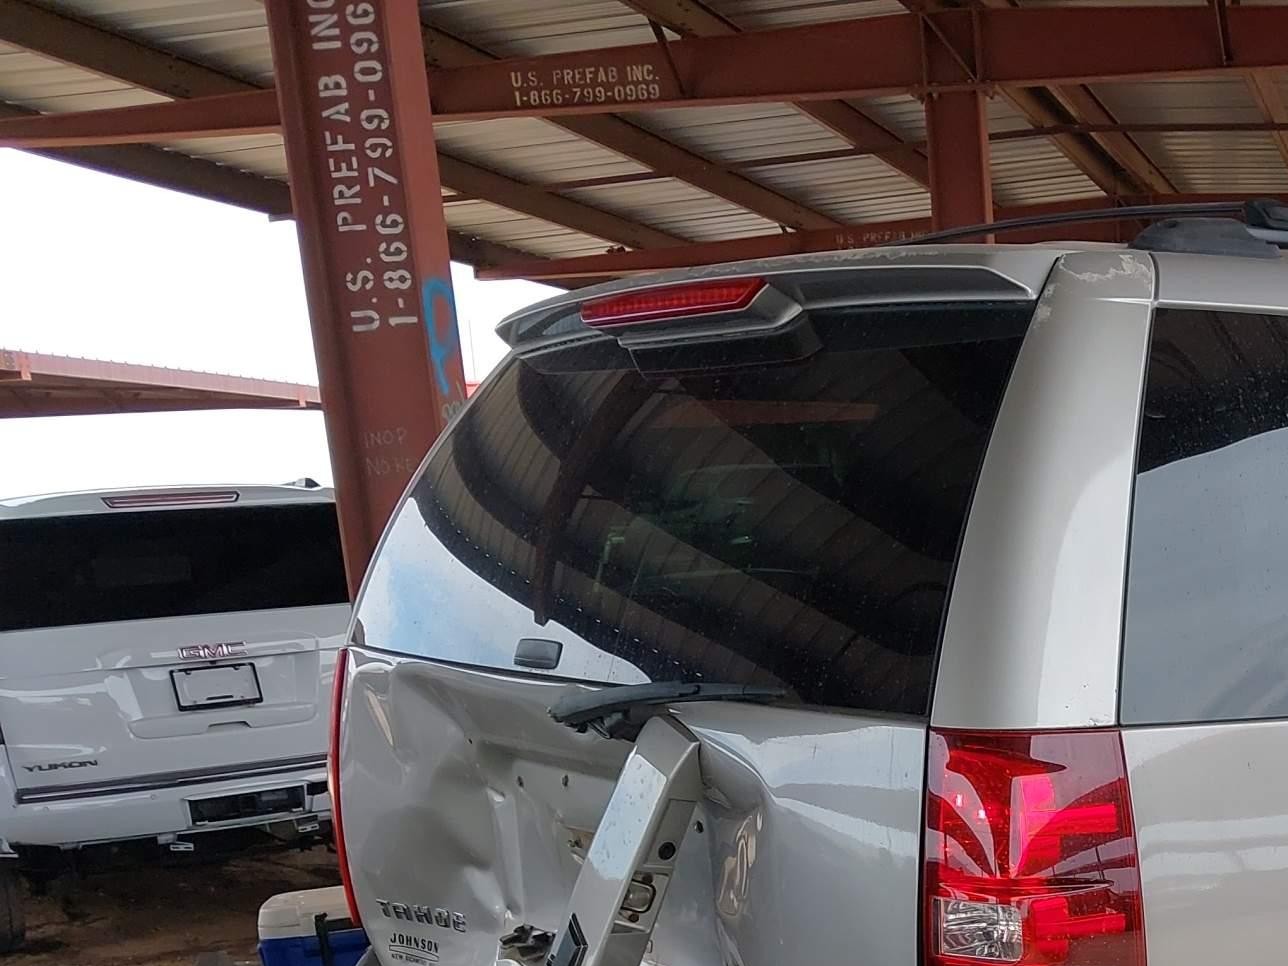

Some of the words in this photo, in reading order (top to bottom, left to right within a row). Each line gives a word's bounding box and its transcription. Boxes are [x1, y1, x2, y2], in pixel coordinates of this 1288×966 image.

[510, 70, 544, 88] U.S.
[552, 66, 618, 86] PREFAB
[626, 64, 660, 83] INC.
[514, 84, 660, 107] 1-866-799-0969
[318, 73, 367, 232] PREFAB
[346, 257, 380, 332] U.S.
[176, 641, 249, 660] GMC
[22, 759, 99, 774] YUKON
[375, 898, 467, 933] TAHOE
[390, 932, 440, 954] JOHNSON
